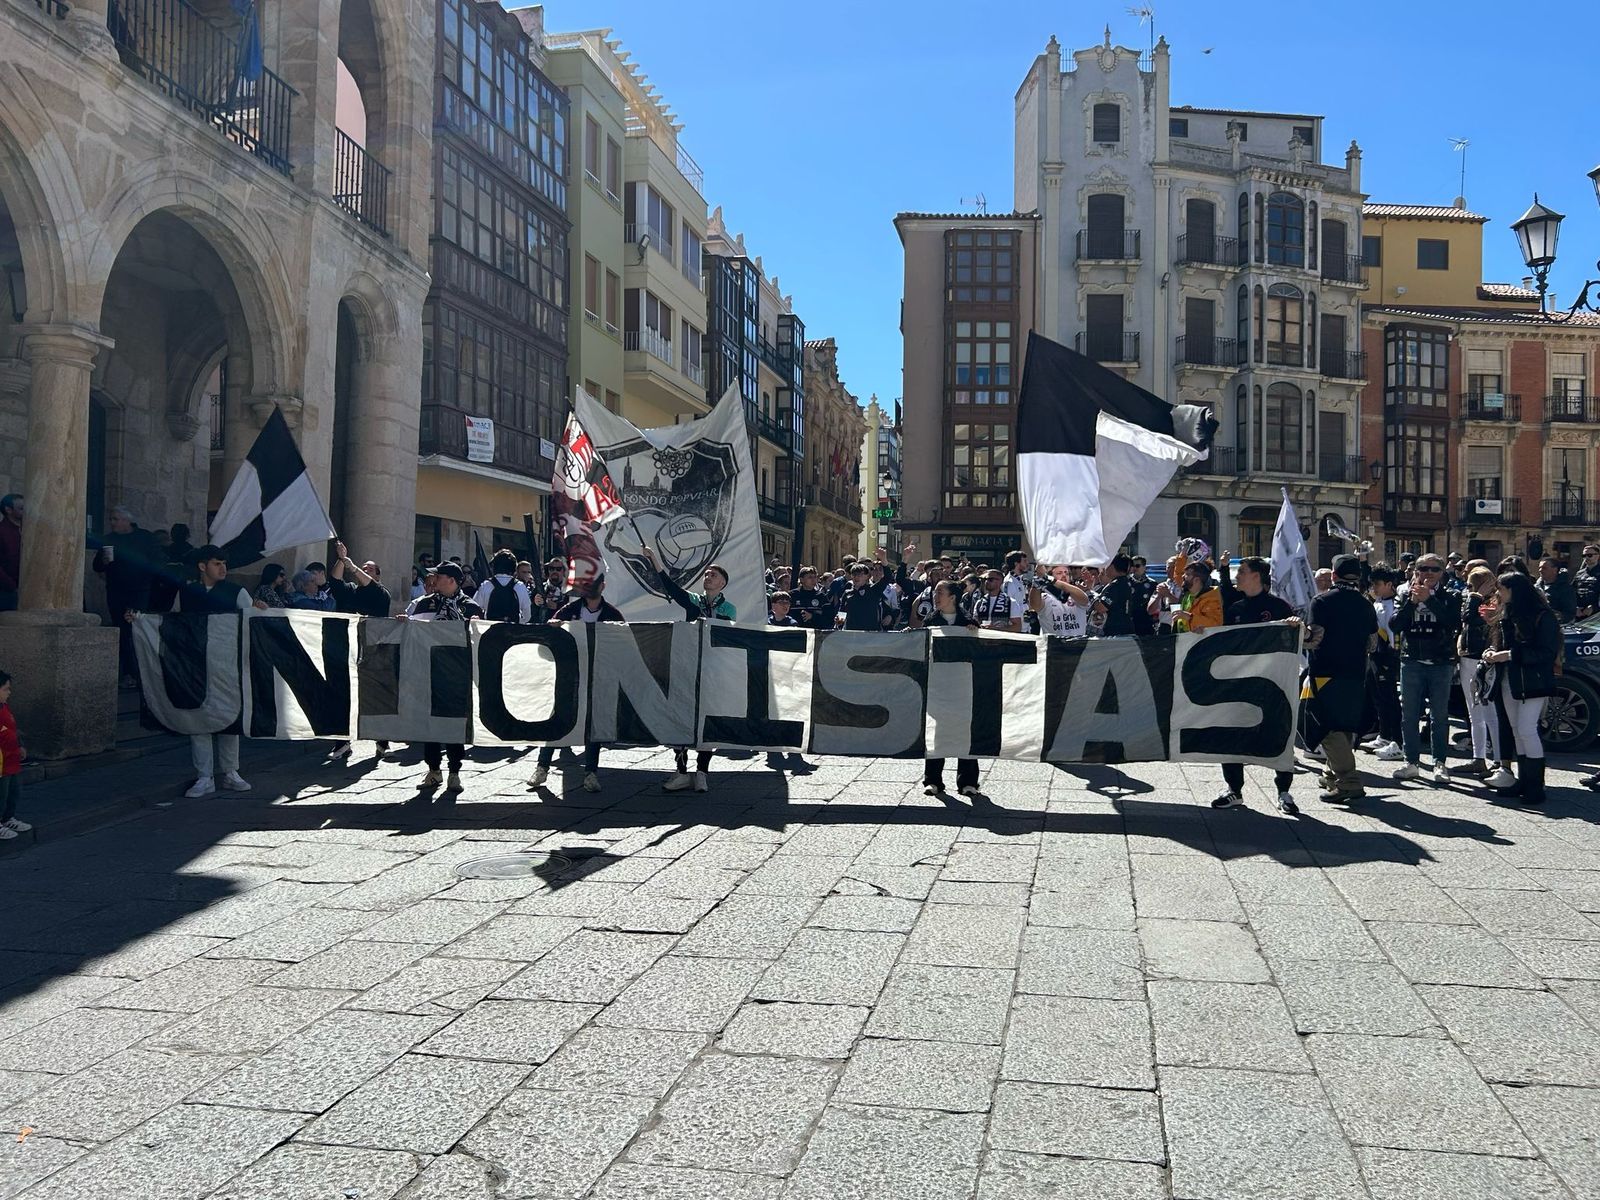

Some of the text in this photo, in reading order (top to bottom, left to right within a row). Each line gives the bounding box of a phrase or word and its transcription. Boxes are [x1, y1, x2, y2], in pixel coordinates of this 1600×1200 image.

[623, 493, 667, 506] FONDO
[875, 509, 894, 518] 14:57
[132, 612, 1299, 762] UNIONISTAS
